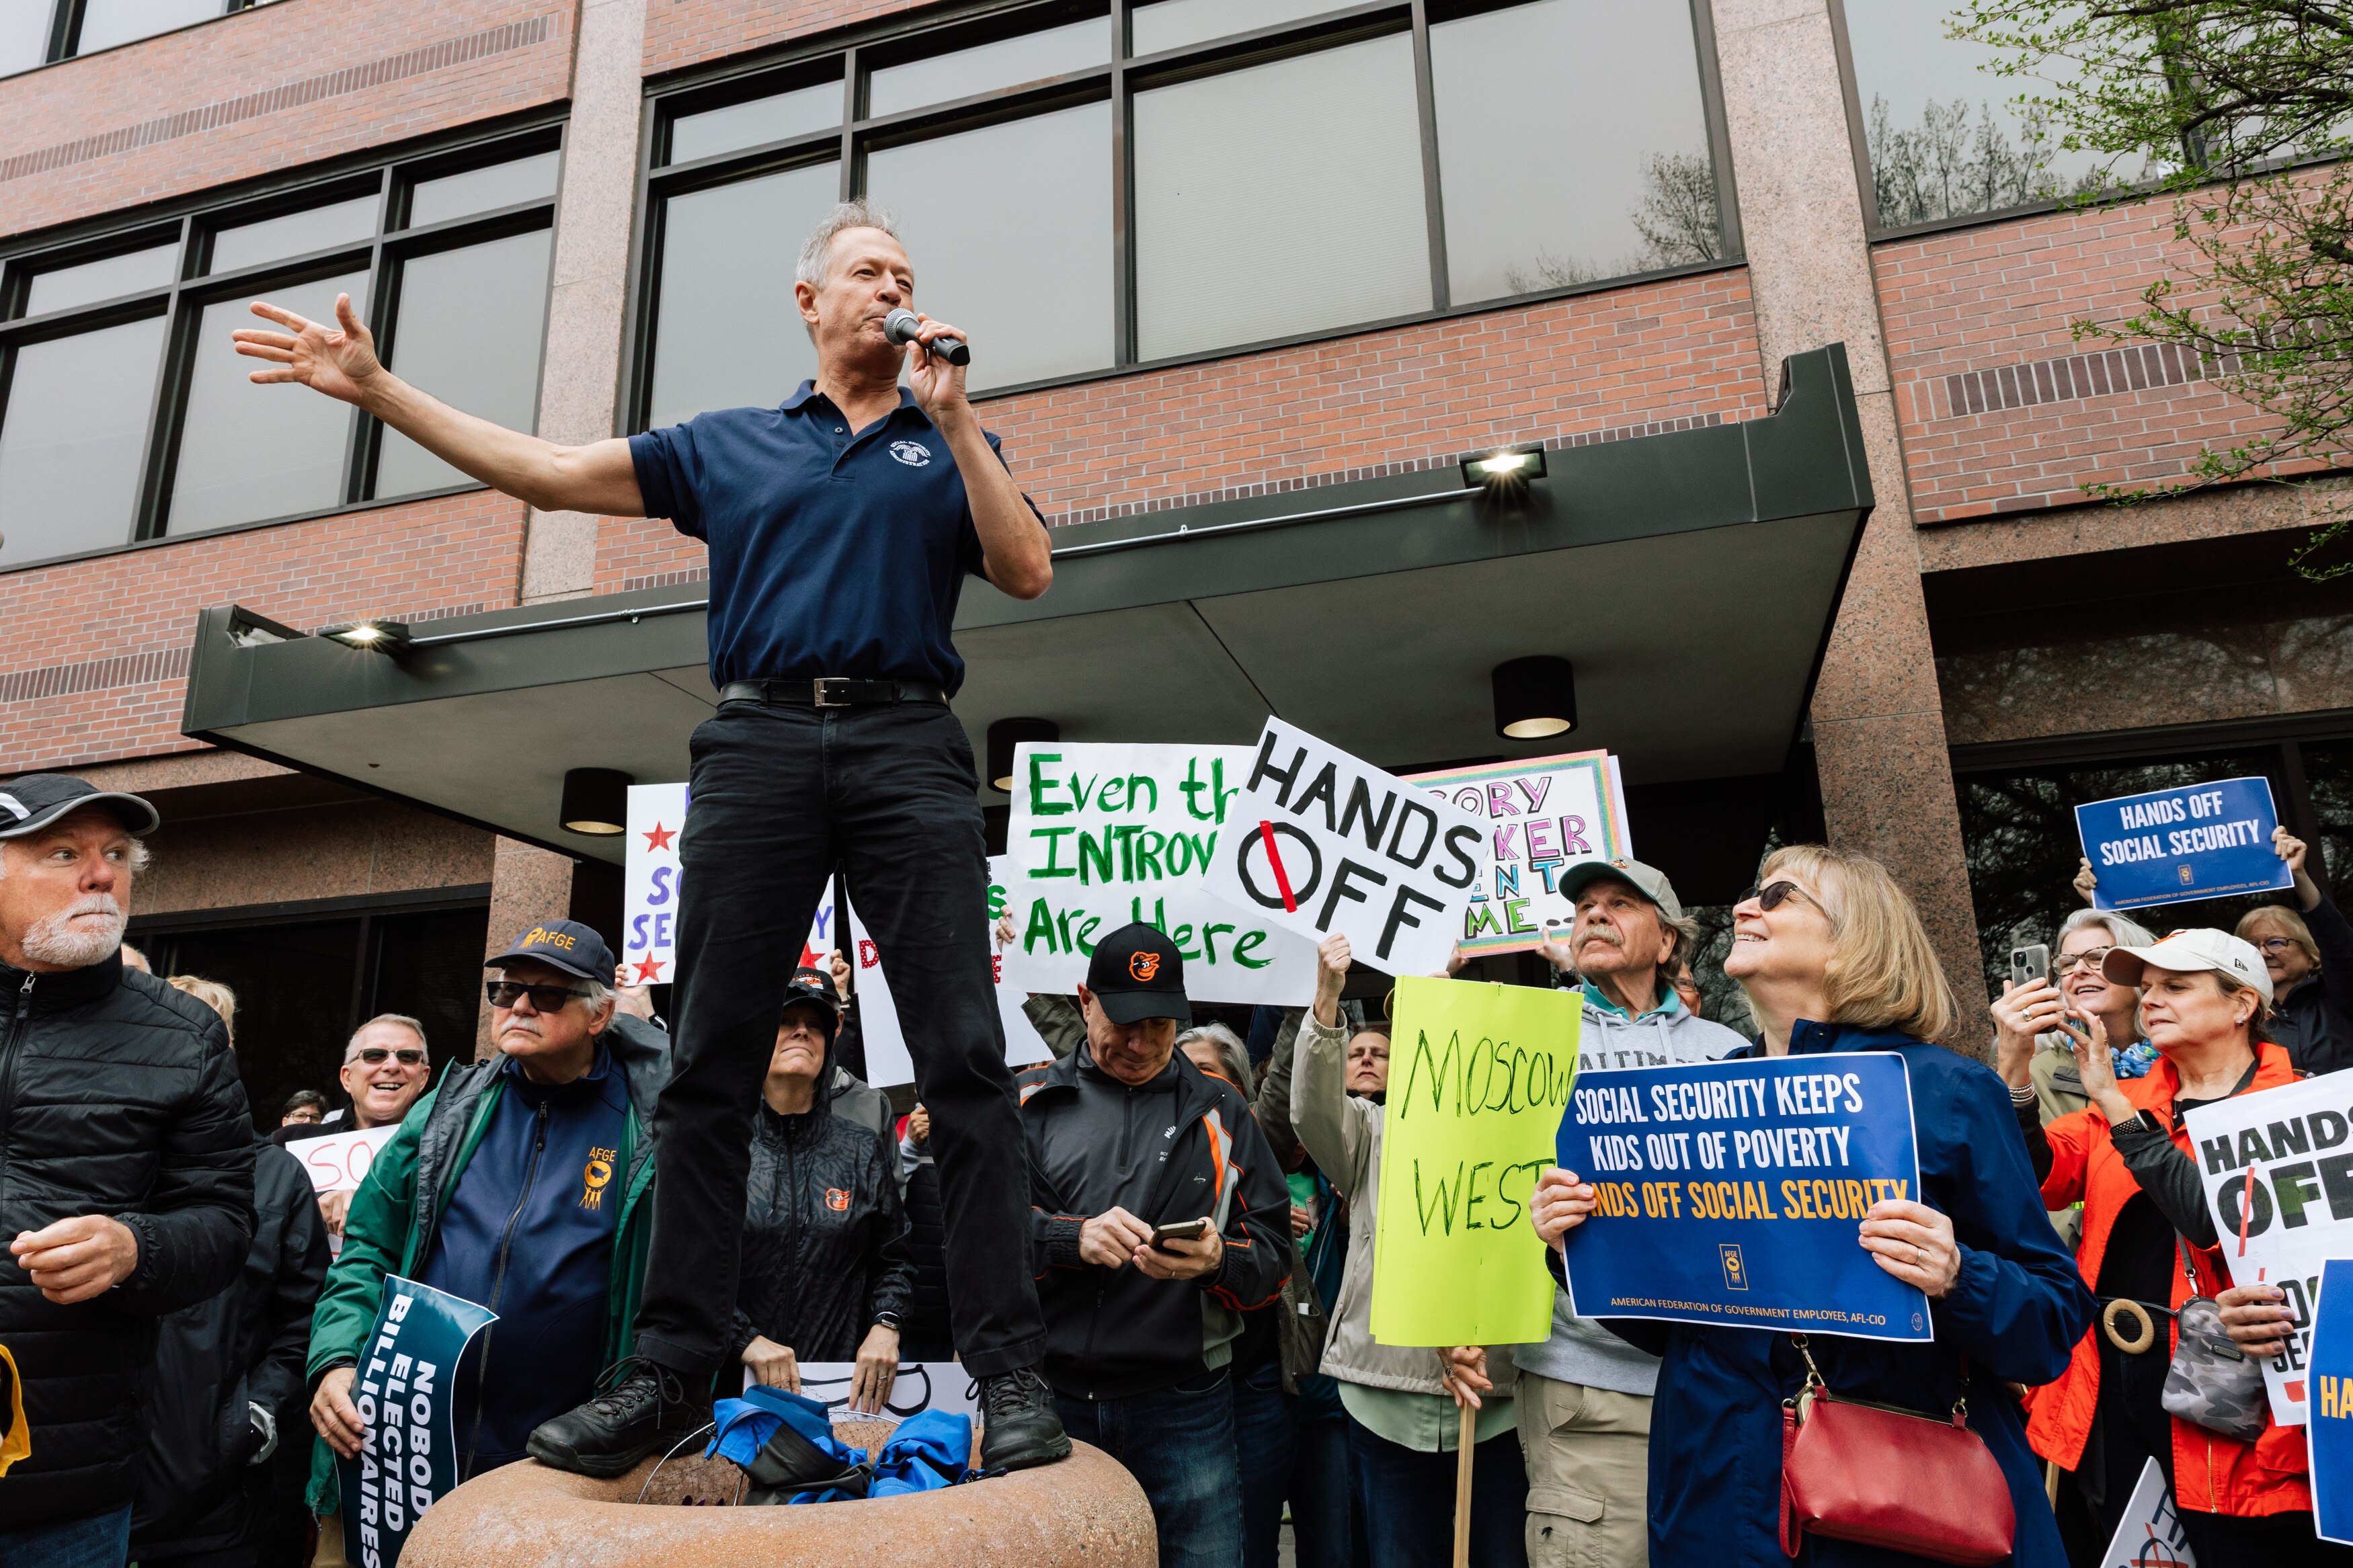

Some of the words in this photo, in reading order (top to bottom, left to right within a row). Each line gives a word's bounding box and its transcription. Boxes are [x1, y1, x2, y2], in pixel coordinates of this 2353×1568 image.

[1029, 753, 1157, 815] Even
[1247, 730, 1482, 889] HANDS
[2120, 798, 2186, 830] HANDS
[2189, 791, 2223, 819] OFF
[1027, 823, 1218, 886] INTROV
[1493, 815, 1592, 861] KER
[2100, 835, 2167, 866] SOCIAL
[2169, 819, 2260, 856] SECURITY
[1238, 821, 1447, 960] OFF
[2114, 896, 2141, 905] AMERICAN
[2141, 893, 2171, 902] FEDERATION
[2180, 886, 2216, 897] GOVERNMENT
[535, 931, 576, 950] AFGE
[1024, 897, 1101, 958] Are
[1401, 1028, 1574, 1120] MOSCOW
[1574, 1086, 1648, 1124] SOCIAL
[1650, 1078, 1766, 1122] SECURITY
[1773, 1073, 1863, 1116] KEEPS
[588, 1146, 617, 1162] AFGE
[1589, 1134, 1643, 1171] KIDS
[1646, 1132, 1690, 1171] OUT
[1697, 1131, 1726, 1169] OF
[1733, 1126, 1849, 1169] POVERTY
[2200, 1106, 2353, 1175] HAND
[1414, 1158, 1556, 1236] WEST
[1582, 1182, 1639, 1217] NDS
[1641, 1182, 1681, 1218] OFF
[1687, 1181, 1778, 1219] SOCIAL
[1781, 1179, 1907, 1219] SECURITY
[2217, 1153, 2353, 1238] OFF
[1611, 1297, 1657, 1307] AMERICAN
[1657, 1299, 1709, 1312] FEDERATION
[1710, 1303, 1723, 1313] OF
[1724, 1305, 1790, 1318] GOVERNMENT
[1793, 1309, 1849, 1323] EMPLOYEES,
[1850, 1313, 1886, 1325] AFL-CIO
[358, 1294, 413, 1568] BILLIONAIRES
[383, 1352, 413, 1531] ELECTED
[409, 1360, 436, 1527] NOBOD
